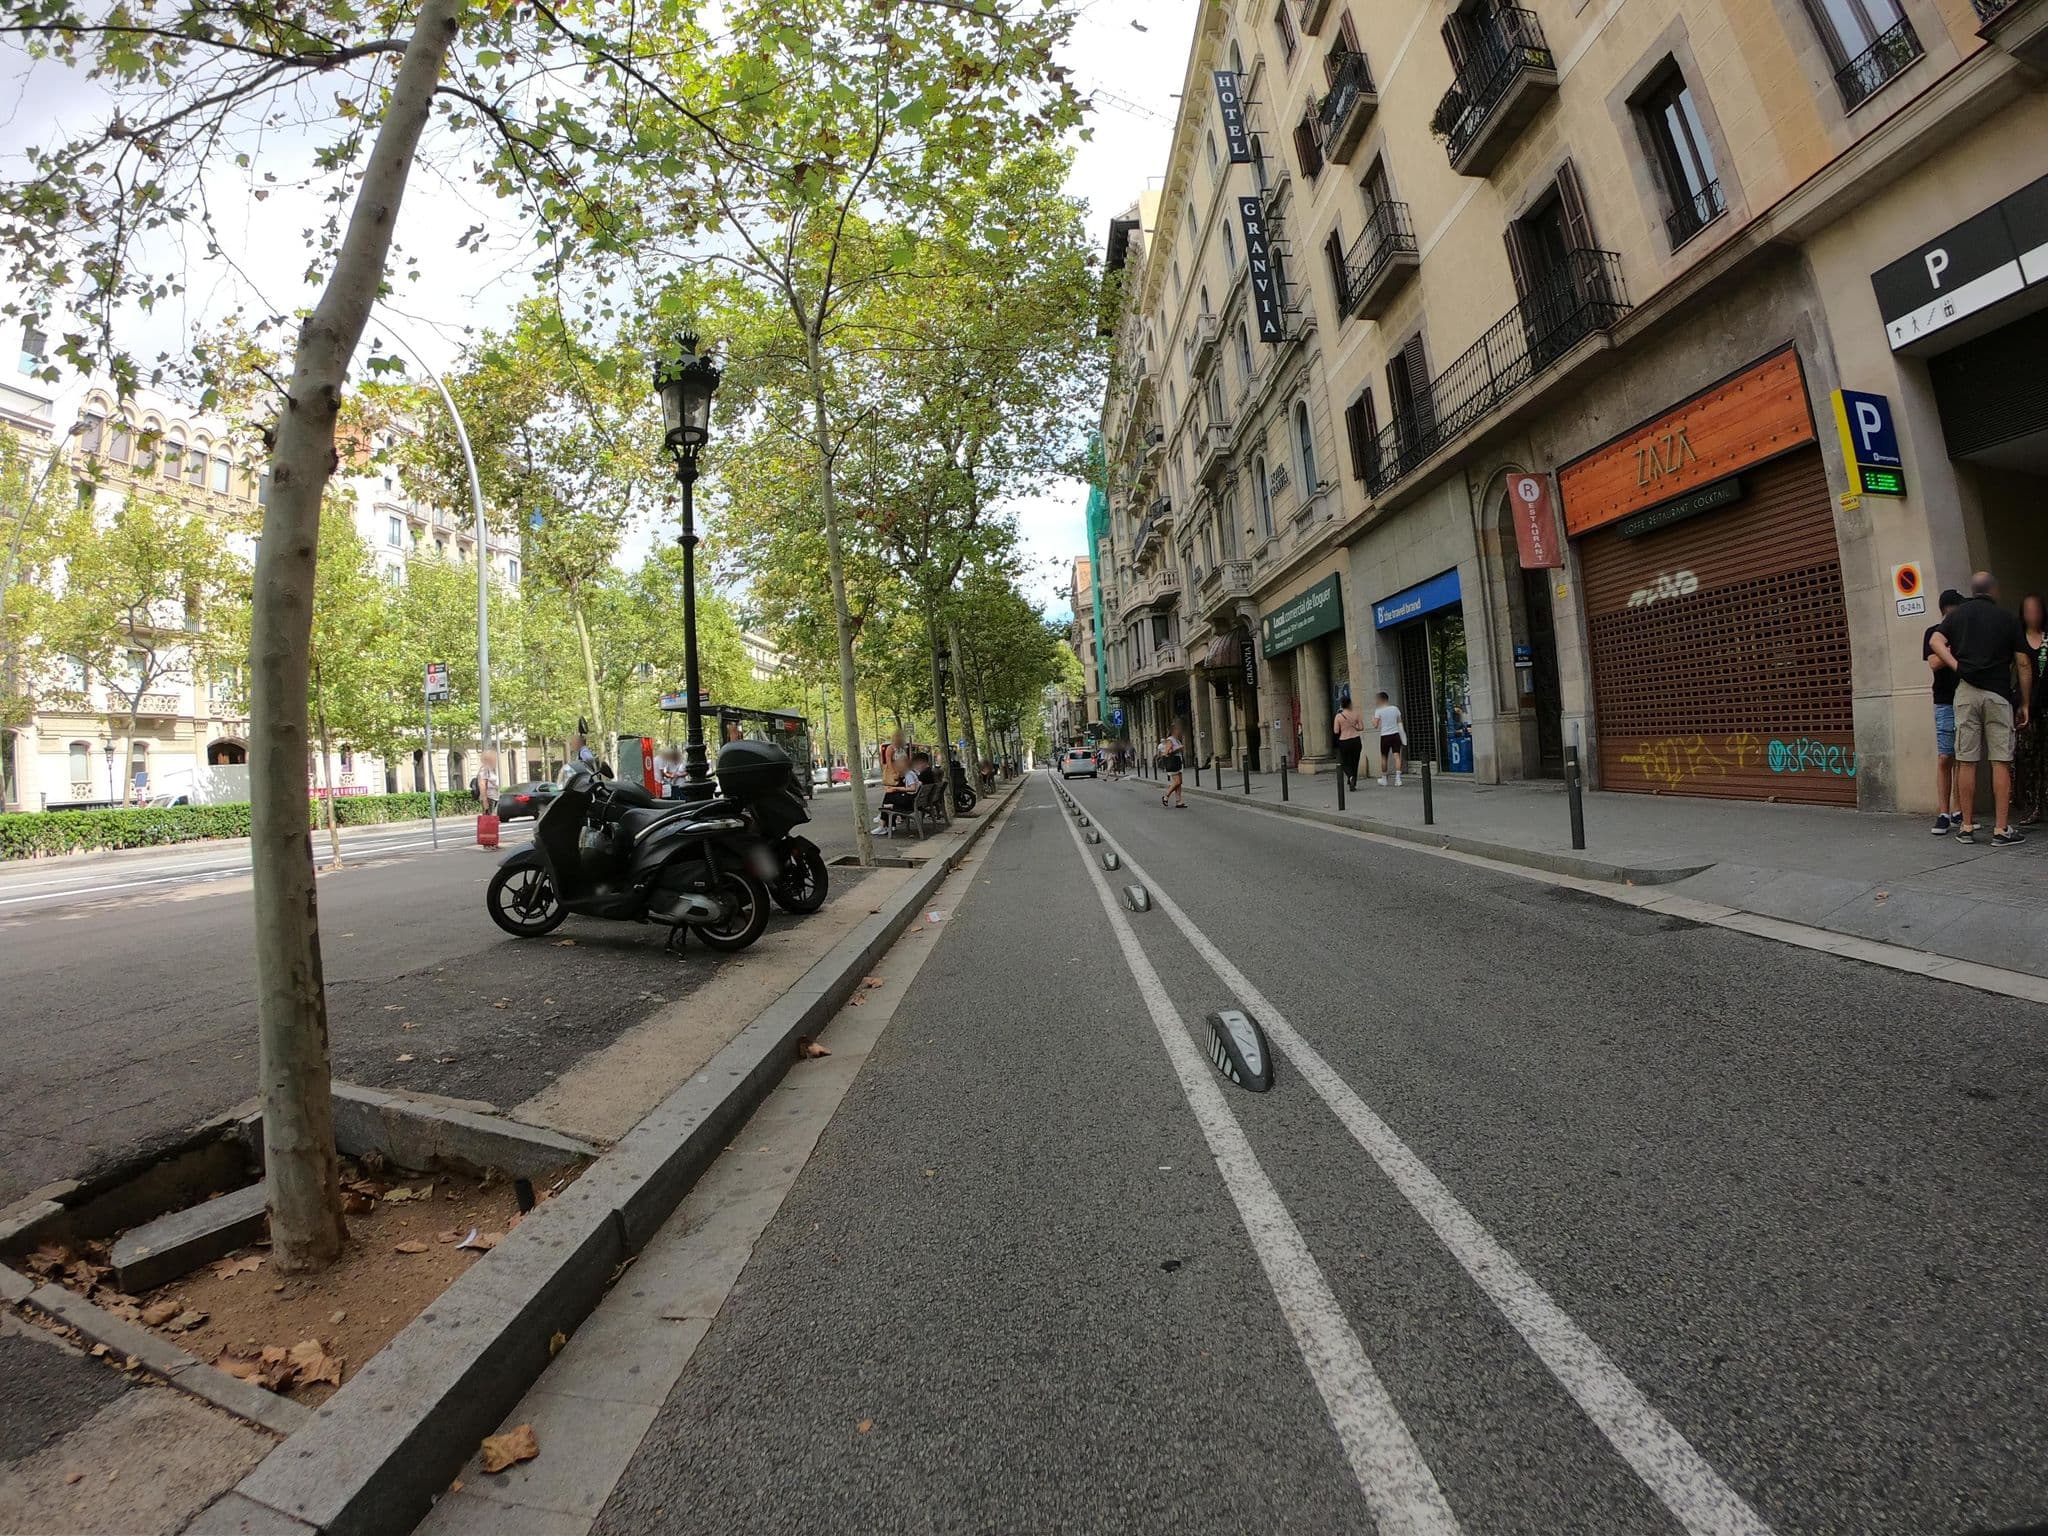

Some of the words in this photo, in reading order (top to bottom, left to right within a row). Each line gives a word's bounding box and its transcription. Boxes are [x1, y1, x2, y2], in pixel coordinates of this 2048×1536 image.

[1218, 76, 1245, 154] HOTEL
[1243, 203, 1276, 333] GRANVIA
[1924, 248, 1950, 290] P
[1855, 401, 1882, 451] P
[1632, 426, 1697, 486] ZAZA
[1648, 502, 1689, 526] RESTAURANT
[1693, 489, 1730, 509] COCKTAIL
[1273, 611, 1285, 629] Local
[1284, 600, 1306, 622] comercial
[1305, 597, 1313, 612] de
[1312, 588, 1331, 608] lloguer
[1384, 608, 1392, 621] the
[1391, 604, 1405, 618] travel
[1405, 597, 1421, 614] brand
[1244, 646, 1254, 685] GRANVIA
[1451, 742, 1460, 764] B
